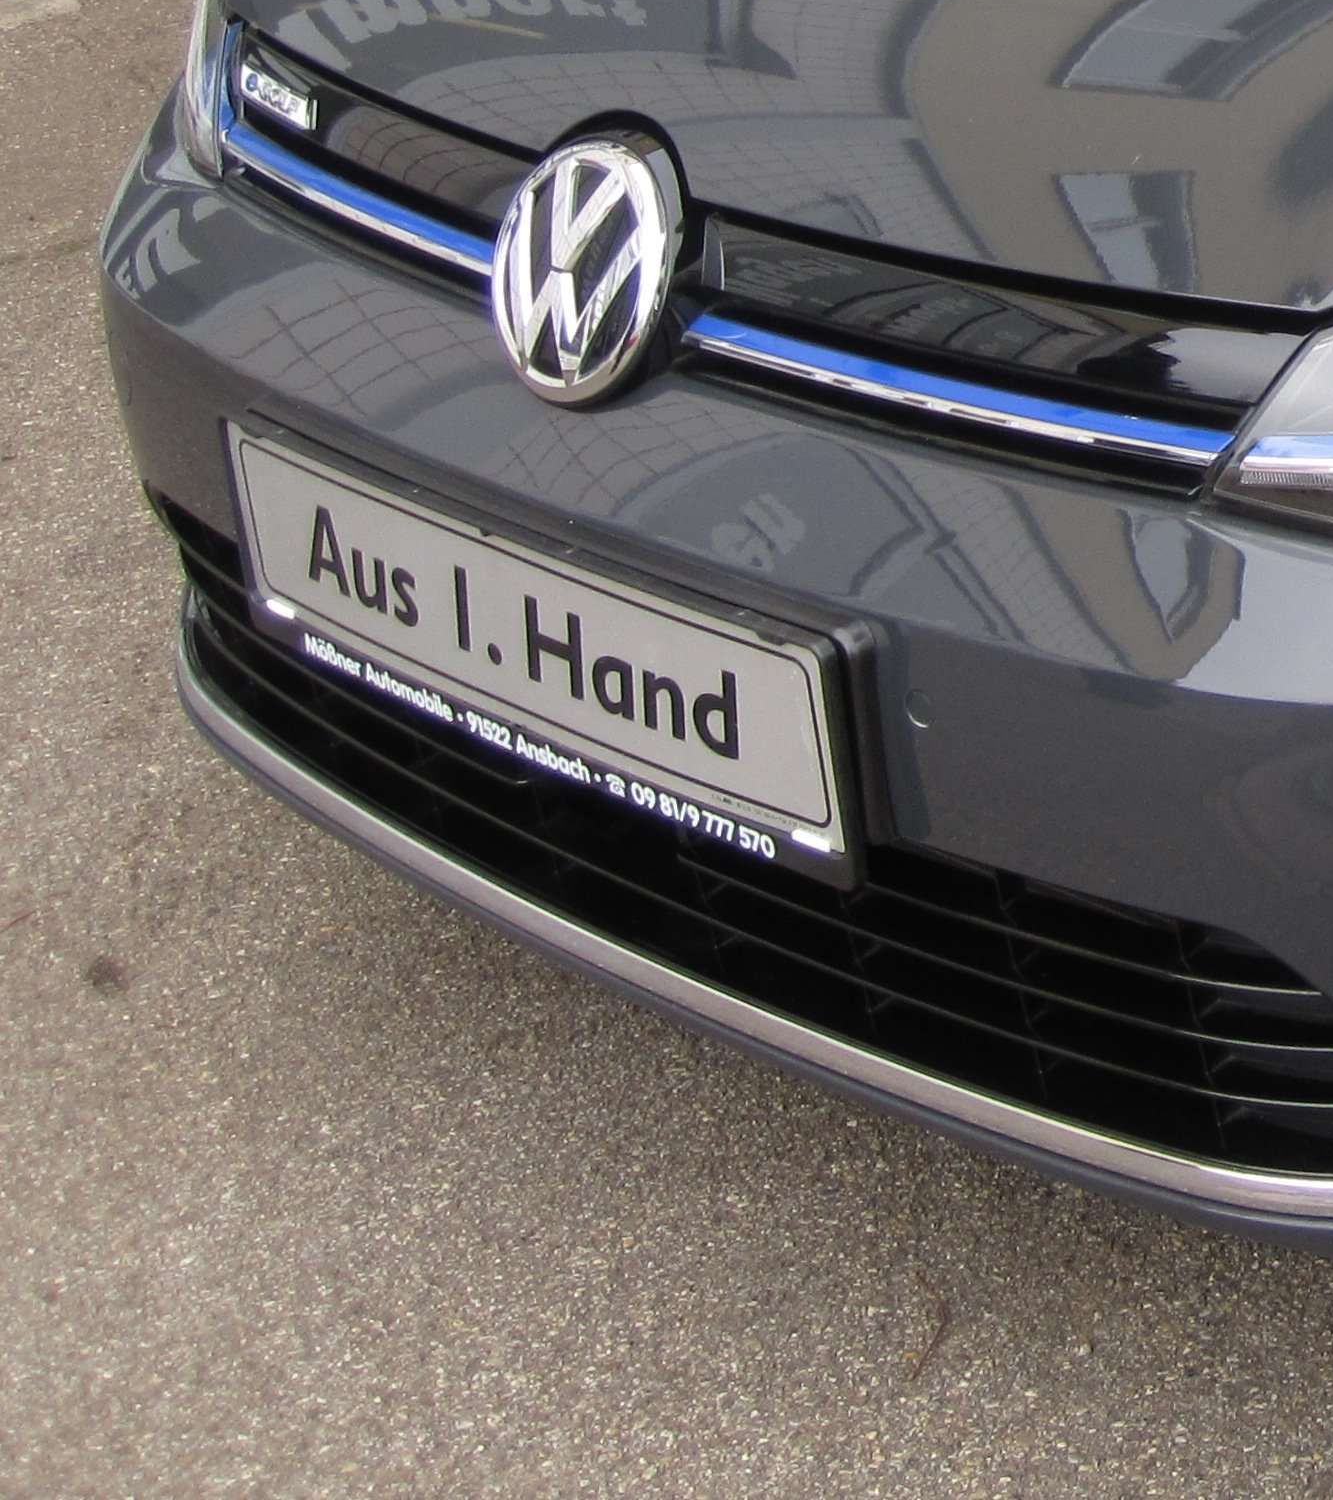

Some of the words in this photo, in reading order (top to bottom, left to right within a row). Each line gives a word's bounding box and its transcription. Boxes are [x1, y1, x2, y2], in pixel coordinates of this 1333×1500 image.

[303, 632, 362, 678] Mößner
[364, 662, 455, 723] Automobile
[465, 710, 513, 750] 91522
[516, 733, 592, 785] Ansbach
[630, 781, 657, 810] 09
[738, 823, 777, 860] 570
[308, 505, 420, 628] Aus
[523, 594, 741, 761] Hand
